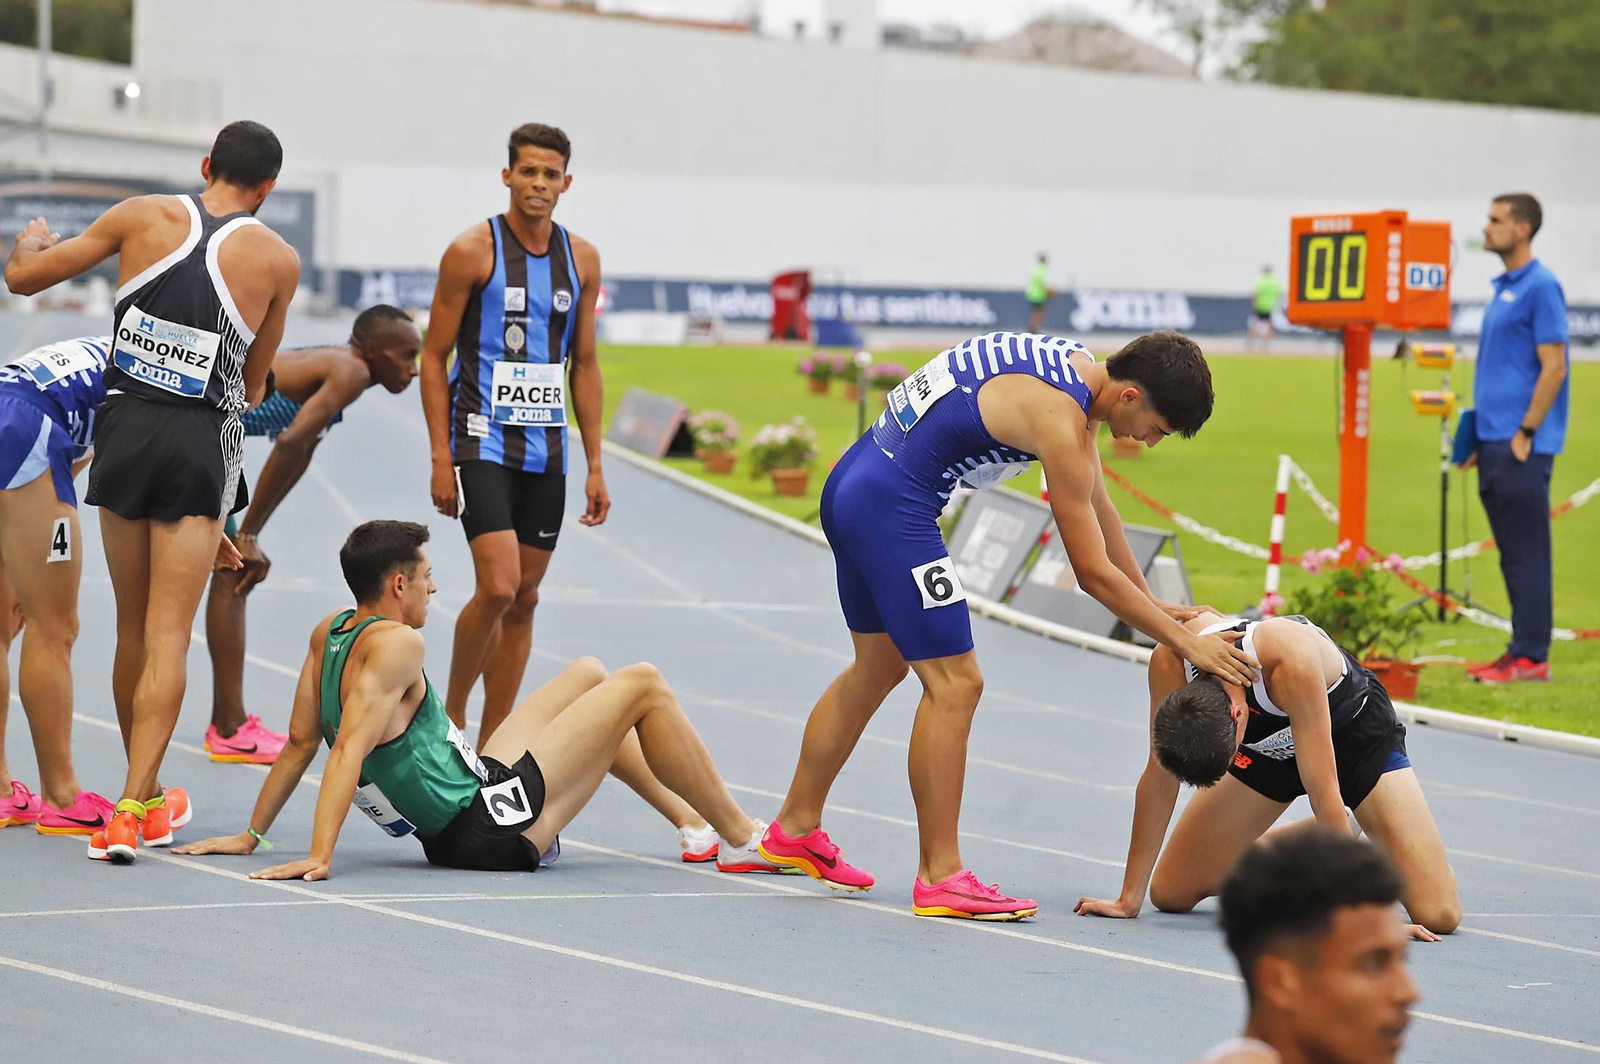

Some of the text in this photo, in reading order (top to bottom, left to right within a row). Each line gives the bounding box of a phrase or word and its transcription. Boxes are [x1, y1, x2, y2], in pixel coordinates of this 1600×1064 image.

[1305, 234, 1367, 300] 00
[119, 328, 210, 369] ORDOÑEZ
[168, 331, 198, 344] HUELVA
[128, 358, 182, 389] Joma
[157, 357, 166, 366] 4
[497, 385, 562, 404] PACER
[509, 407, 552, 422] Joma
[52, 522, 67, 556] 4
[923, 565, 954, 602] 6
[490, 786, 526, 818] 2
